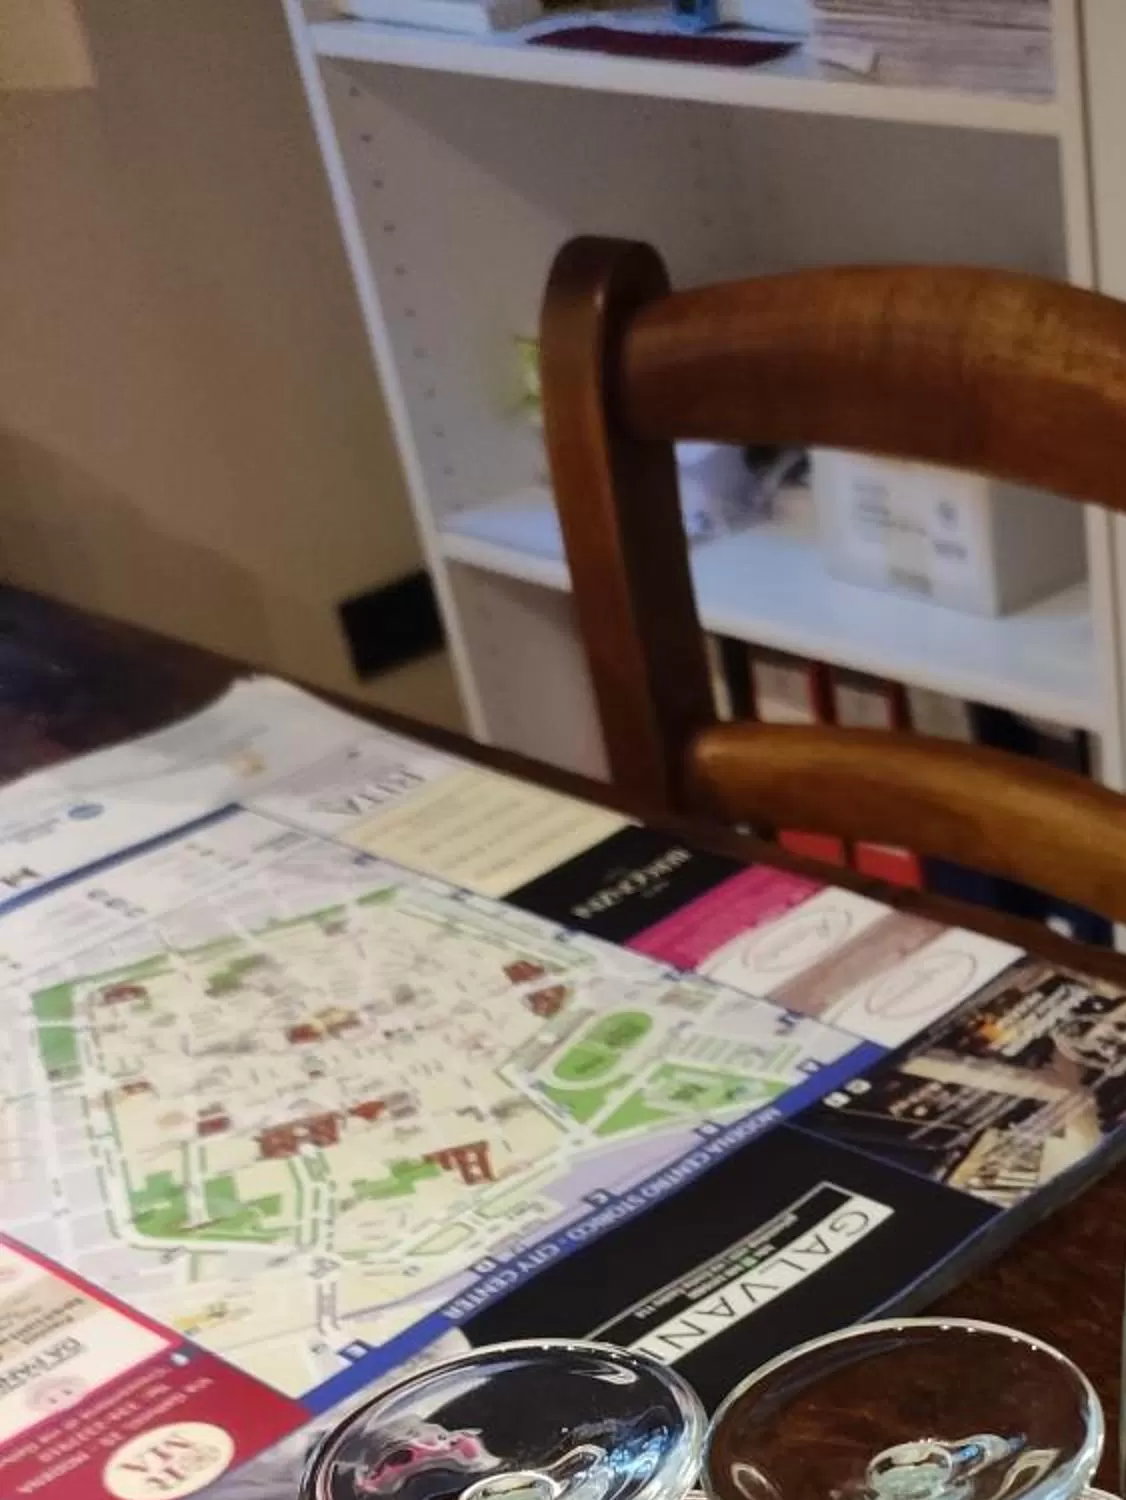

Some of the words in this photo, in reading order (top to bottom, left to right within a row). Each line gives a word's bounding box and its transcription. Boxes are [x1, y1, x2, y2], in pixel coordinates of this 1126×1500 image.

[514, 1240, 560, 1274] CITY
[440, 1268, 519, 1322] CENTER
[639, 1210, 870, 1361] GALVANI
